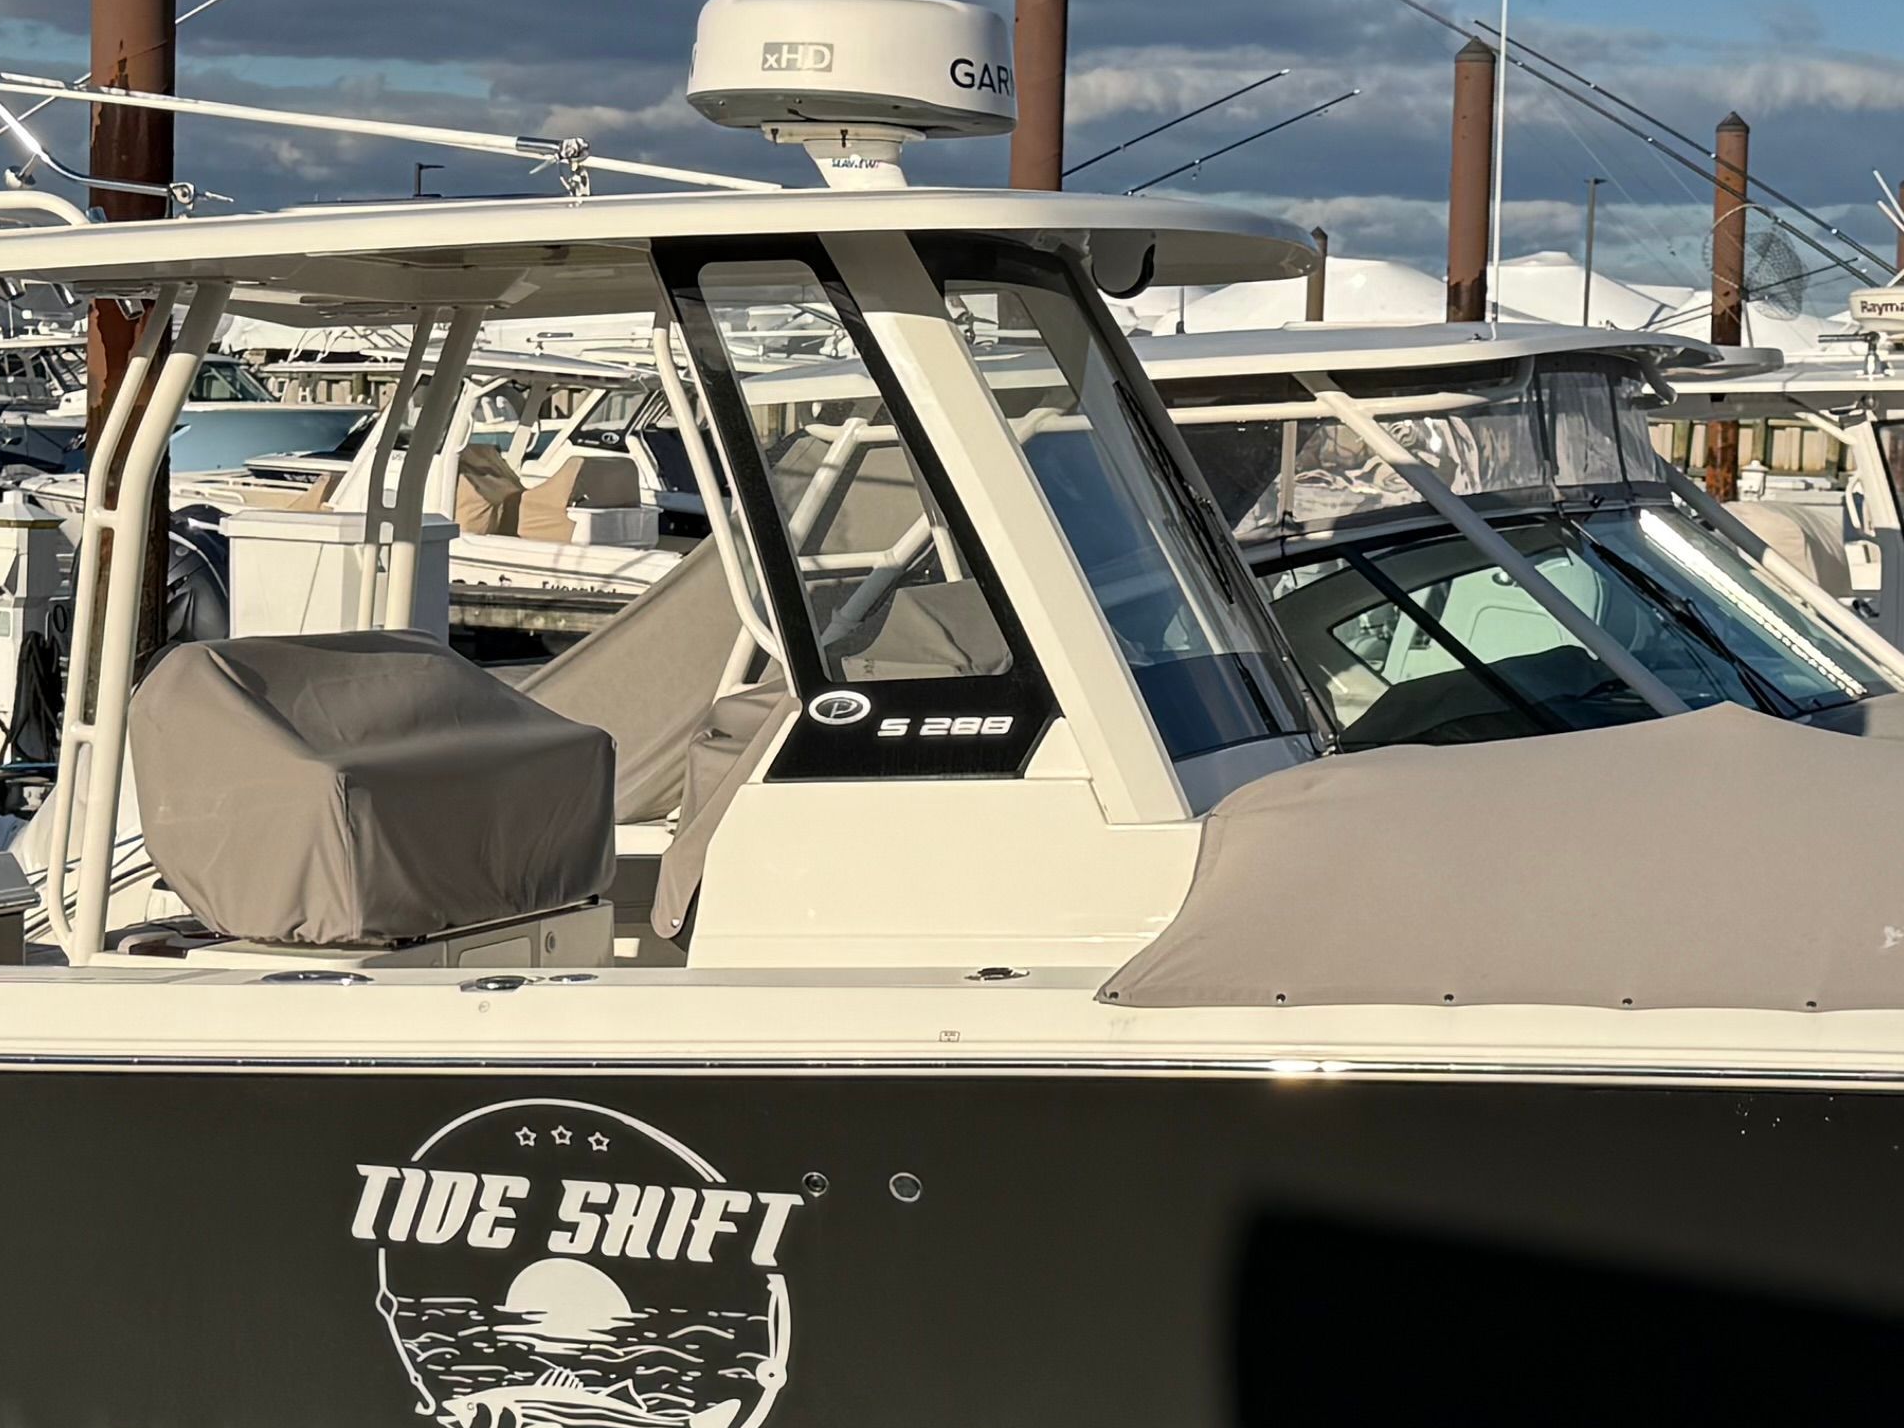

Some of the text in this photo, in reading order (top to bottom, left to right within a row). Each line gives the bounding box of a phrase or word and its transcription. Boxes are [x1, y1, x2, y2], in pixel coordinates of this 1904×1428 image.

[763, 44, 832, 70] xHD
[877, 716, 1014, 737] S 288
[351, 1163, 805, 1267] TIDE SHIFT
